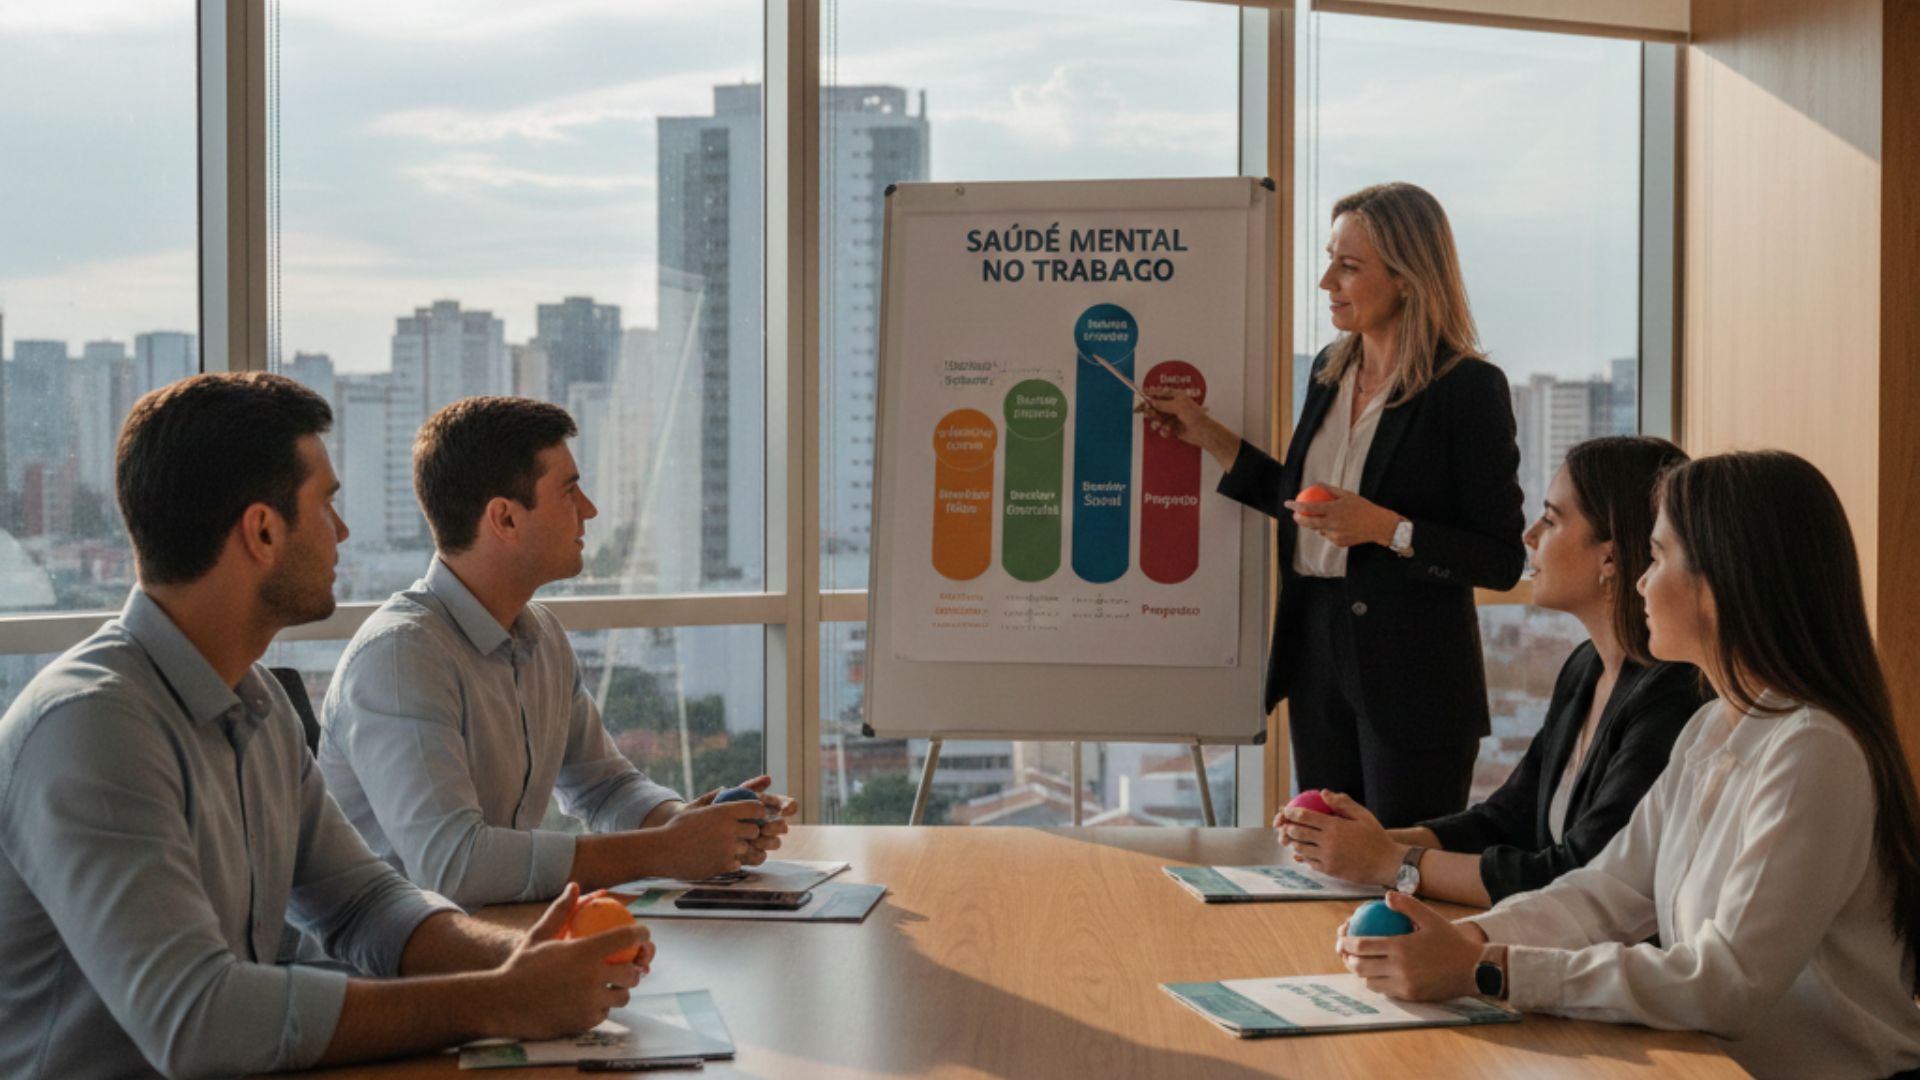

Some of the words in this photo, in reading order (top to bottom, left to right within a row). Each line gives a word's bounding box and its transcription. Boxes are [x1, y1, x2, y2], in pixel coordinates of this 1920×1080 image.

[966, 222, 1061, 252] SAÚDÉ
[1070, 228, 1188, 252] MENTAL
[982, 258, 1025, 282] NO
[1032, 258, 1174, 282] TRABAGO
